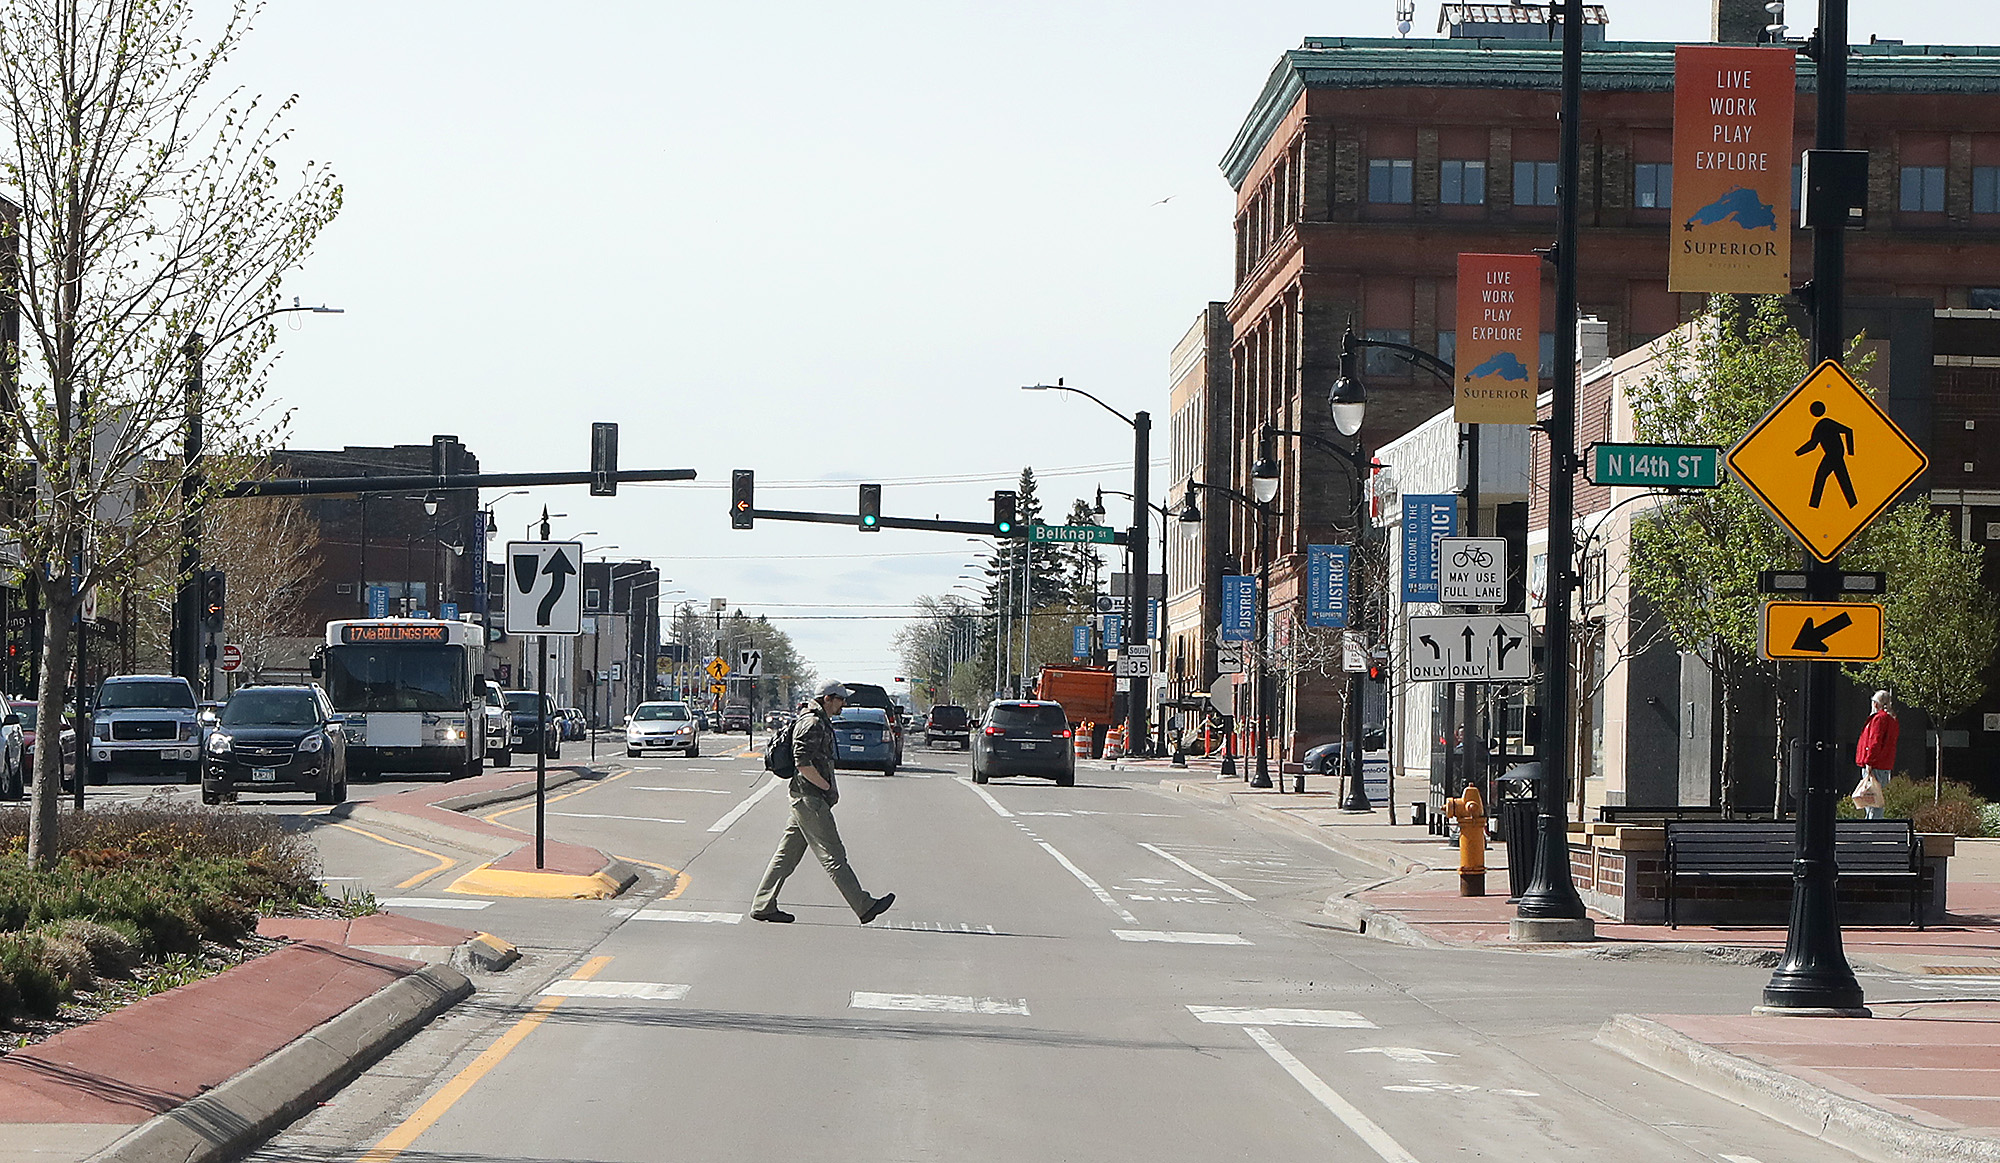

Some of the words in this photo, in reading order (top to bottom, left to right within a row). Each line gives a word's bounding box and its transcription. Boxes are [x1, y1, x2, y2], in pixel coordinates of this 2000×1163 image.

[1717, 70, 1751, 88] LIVE
[1710, 97, 1757, 116] WORK
[1713, 124, 1752, 143] PLAY
[1696, 151, 1767, 171] EXPLORE
[1683, 239, 1777, 256] SUPERIOR
[1486, 271, 1511, 285] LIVE
[1482, 290, 1515, 303] WORK
[1484, 308, 1512, 322] PLAY
[1472, 326, 1523, 341] EXPLORE
[1463, 387, 1529, 399] SUPERIOR
[1608, 454, 1622, 476] N
[1629, 454, 1670, 478] 14th
[1677, 455, 1702, 478] ST
[1408, 503, 1418, 516] THE
[1036, 526, 1095, 542] Belknap
[1408, 523, 1418, 535] TO
[1408, 538, 1418, 580] WELCOME
[1312, 565, 1320, 575] TO
[1329, 552, 1344, 610] DISTRICT
[1449, 573, 1470, 583] MAY
[1476, 573, 1497, 583] USE
[1312, 577, 1320, 609] WELCOME
[1444, 587, 1469, 597] FULL
[1475, 587, 1502, 598] LANE
[1240, 581, 1252, 628] DISTRICT
[350, 627, 363, 641] 17
[377, 627, 421, 640] BILLINGS
[423, 628, 442, 640] PRK
[1129, 647, 1149, 655] SOUTH
[1130, 661, 1148, 674] 35
[1413, 666, 1446, 677] ONLY
[1452, 666, 1485, 677] ONLY
